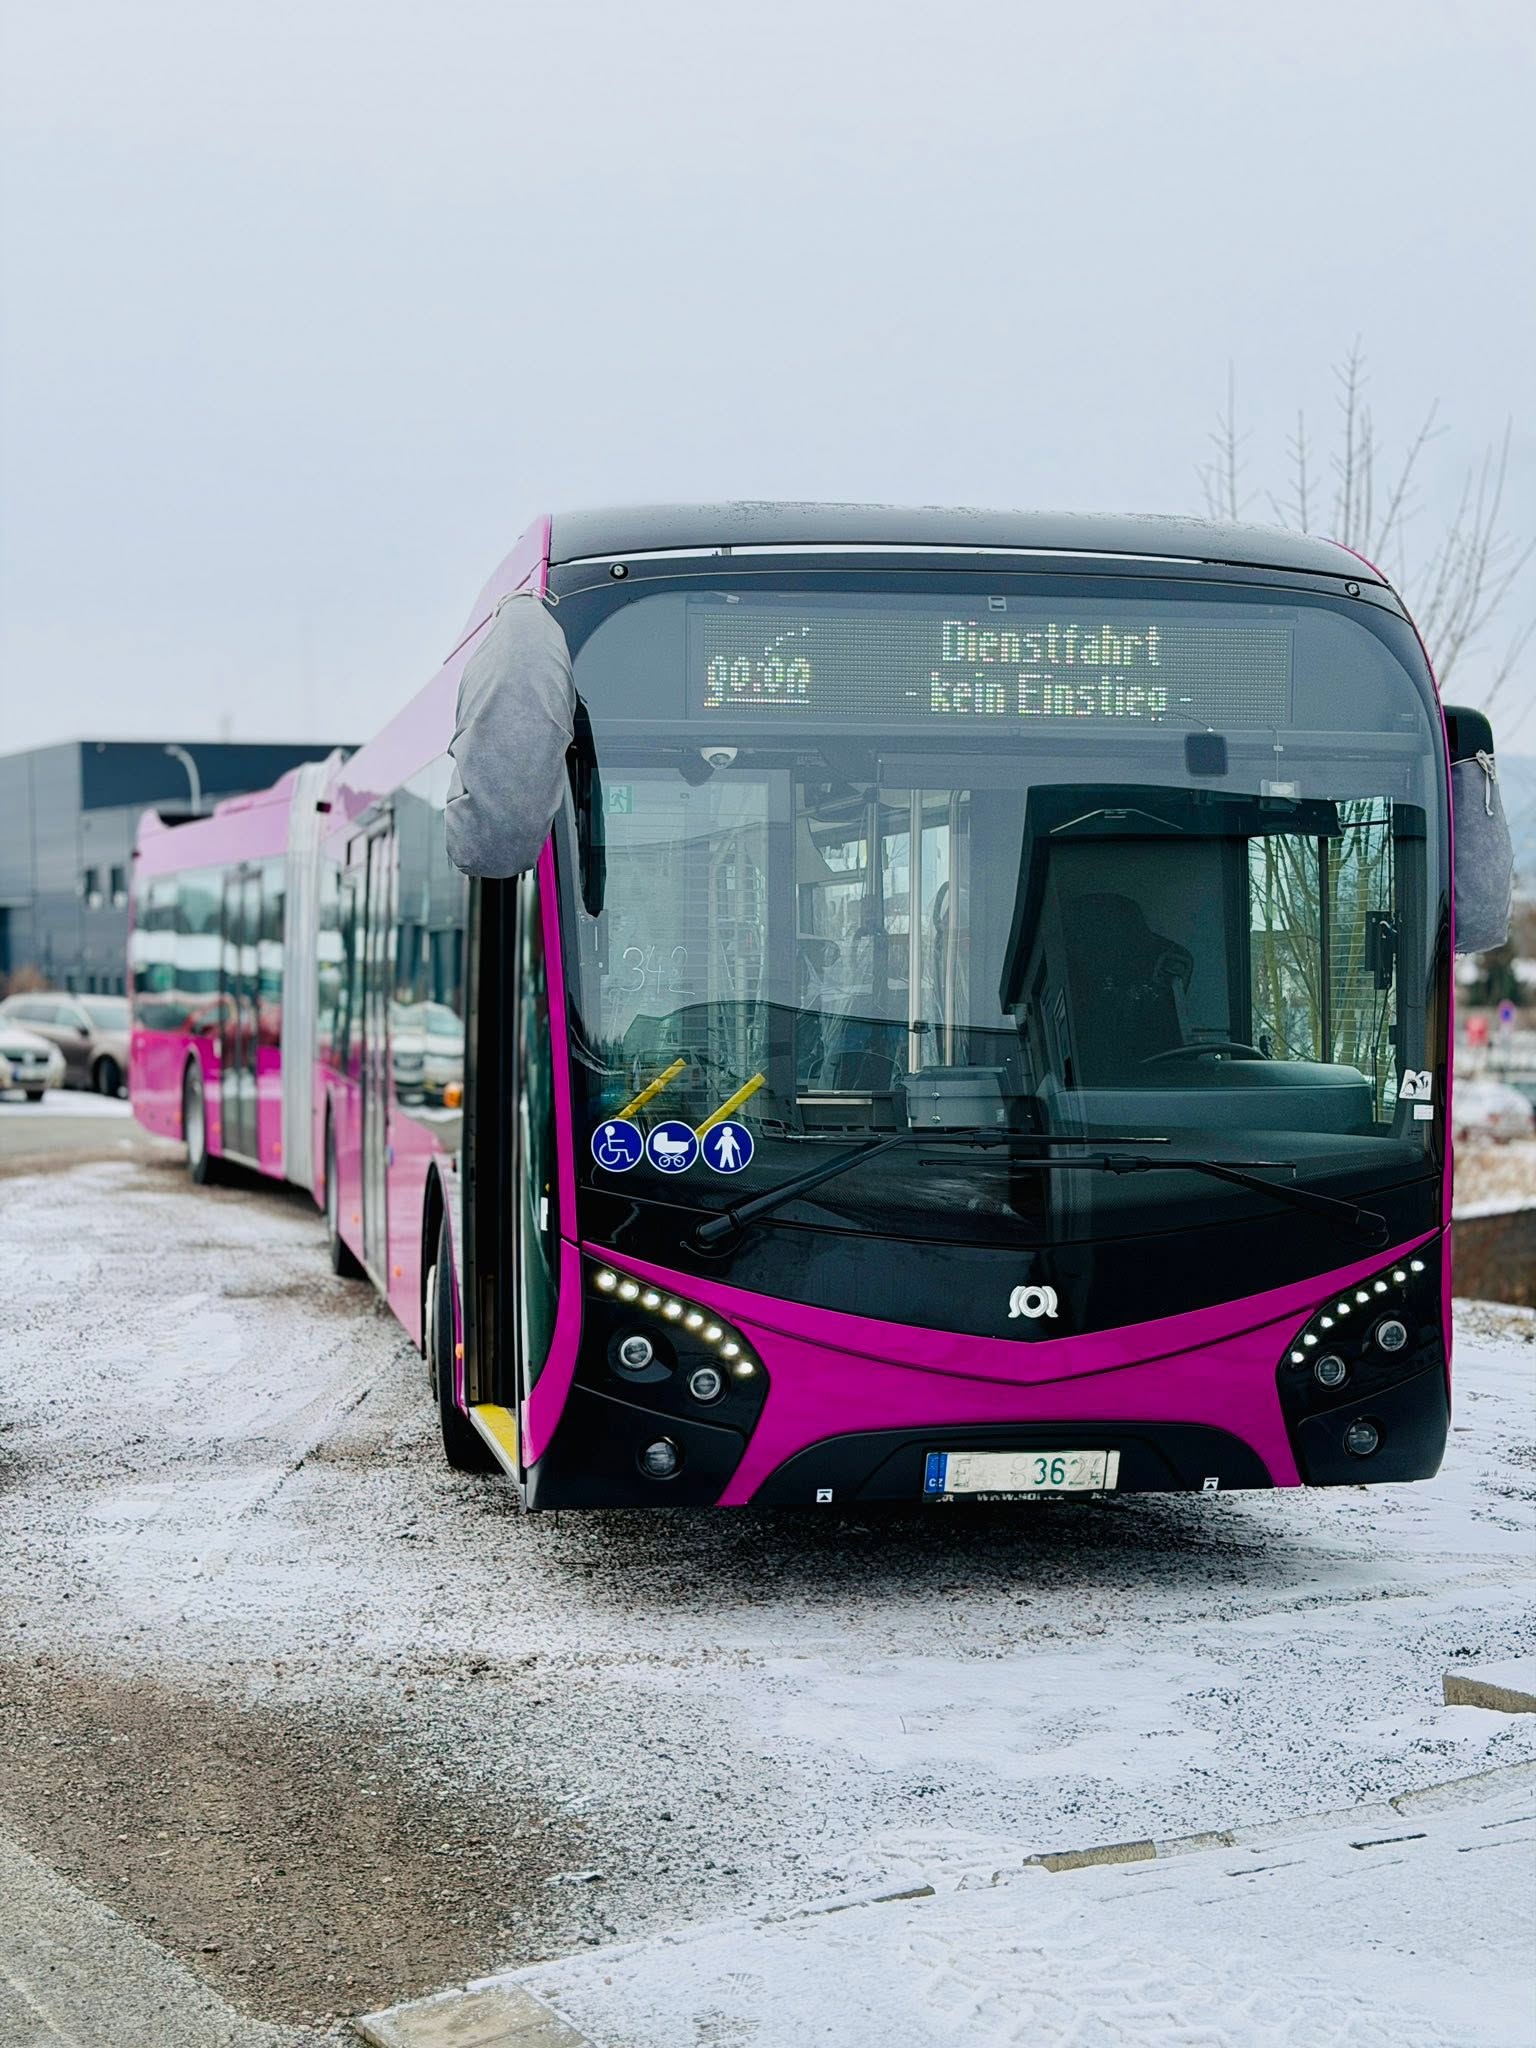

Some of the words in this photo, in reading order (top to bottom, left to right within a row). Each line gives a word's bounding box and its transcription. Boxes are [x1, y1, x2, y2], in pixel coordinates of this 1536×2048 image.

[942, 620, 1162, 666] Dienstfahrt
[930, 671, 1005, 713] kein
[1018, 673, 1168, 721] Einstieg
[928, 1477, 943, 1488] CZ
